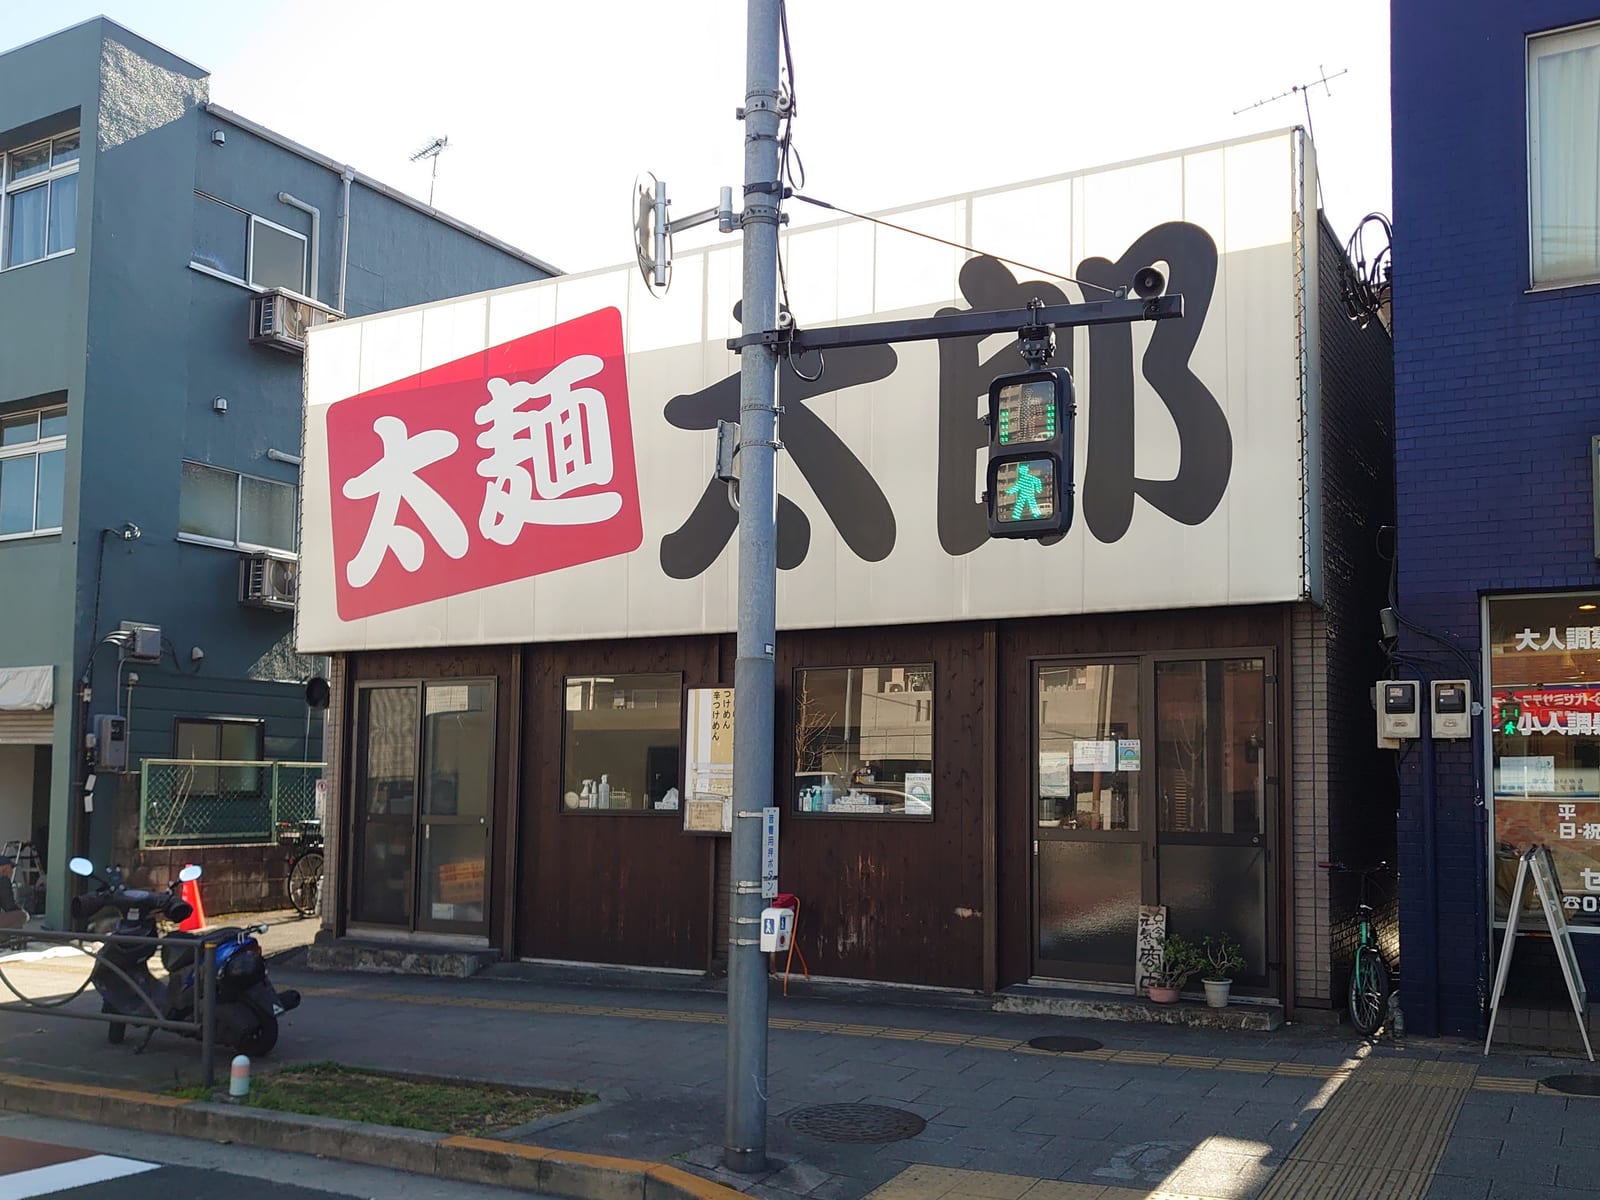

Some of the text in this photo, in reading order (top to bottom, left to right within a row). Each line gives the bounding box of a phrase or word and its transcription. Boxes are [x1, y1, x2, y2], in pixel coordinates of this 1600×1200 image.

[342, 221, 1233, 588] 太麺 太郎
[711, 691, 721, 741] 辛つけめん
[722, 690, 732, 730] つけめん
[1516, 711, 1600, 736] 小人調
[1558, 804, 1576, 821] 平
